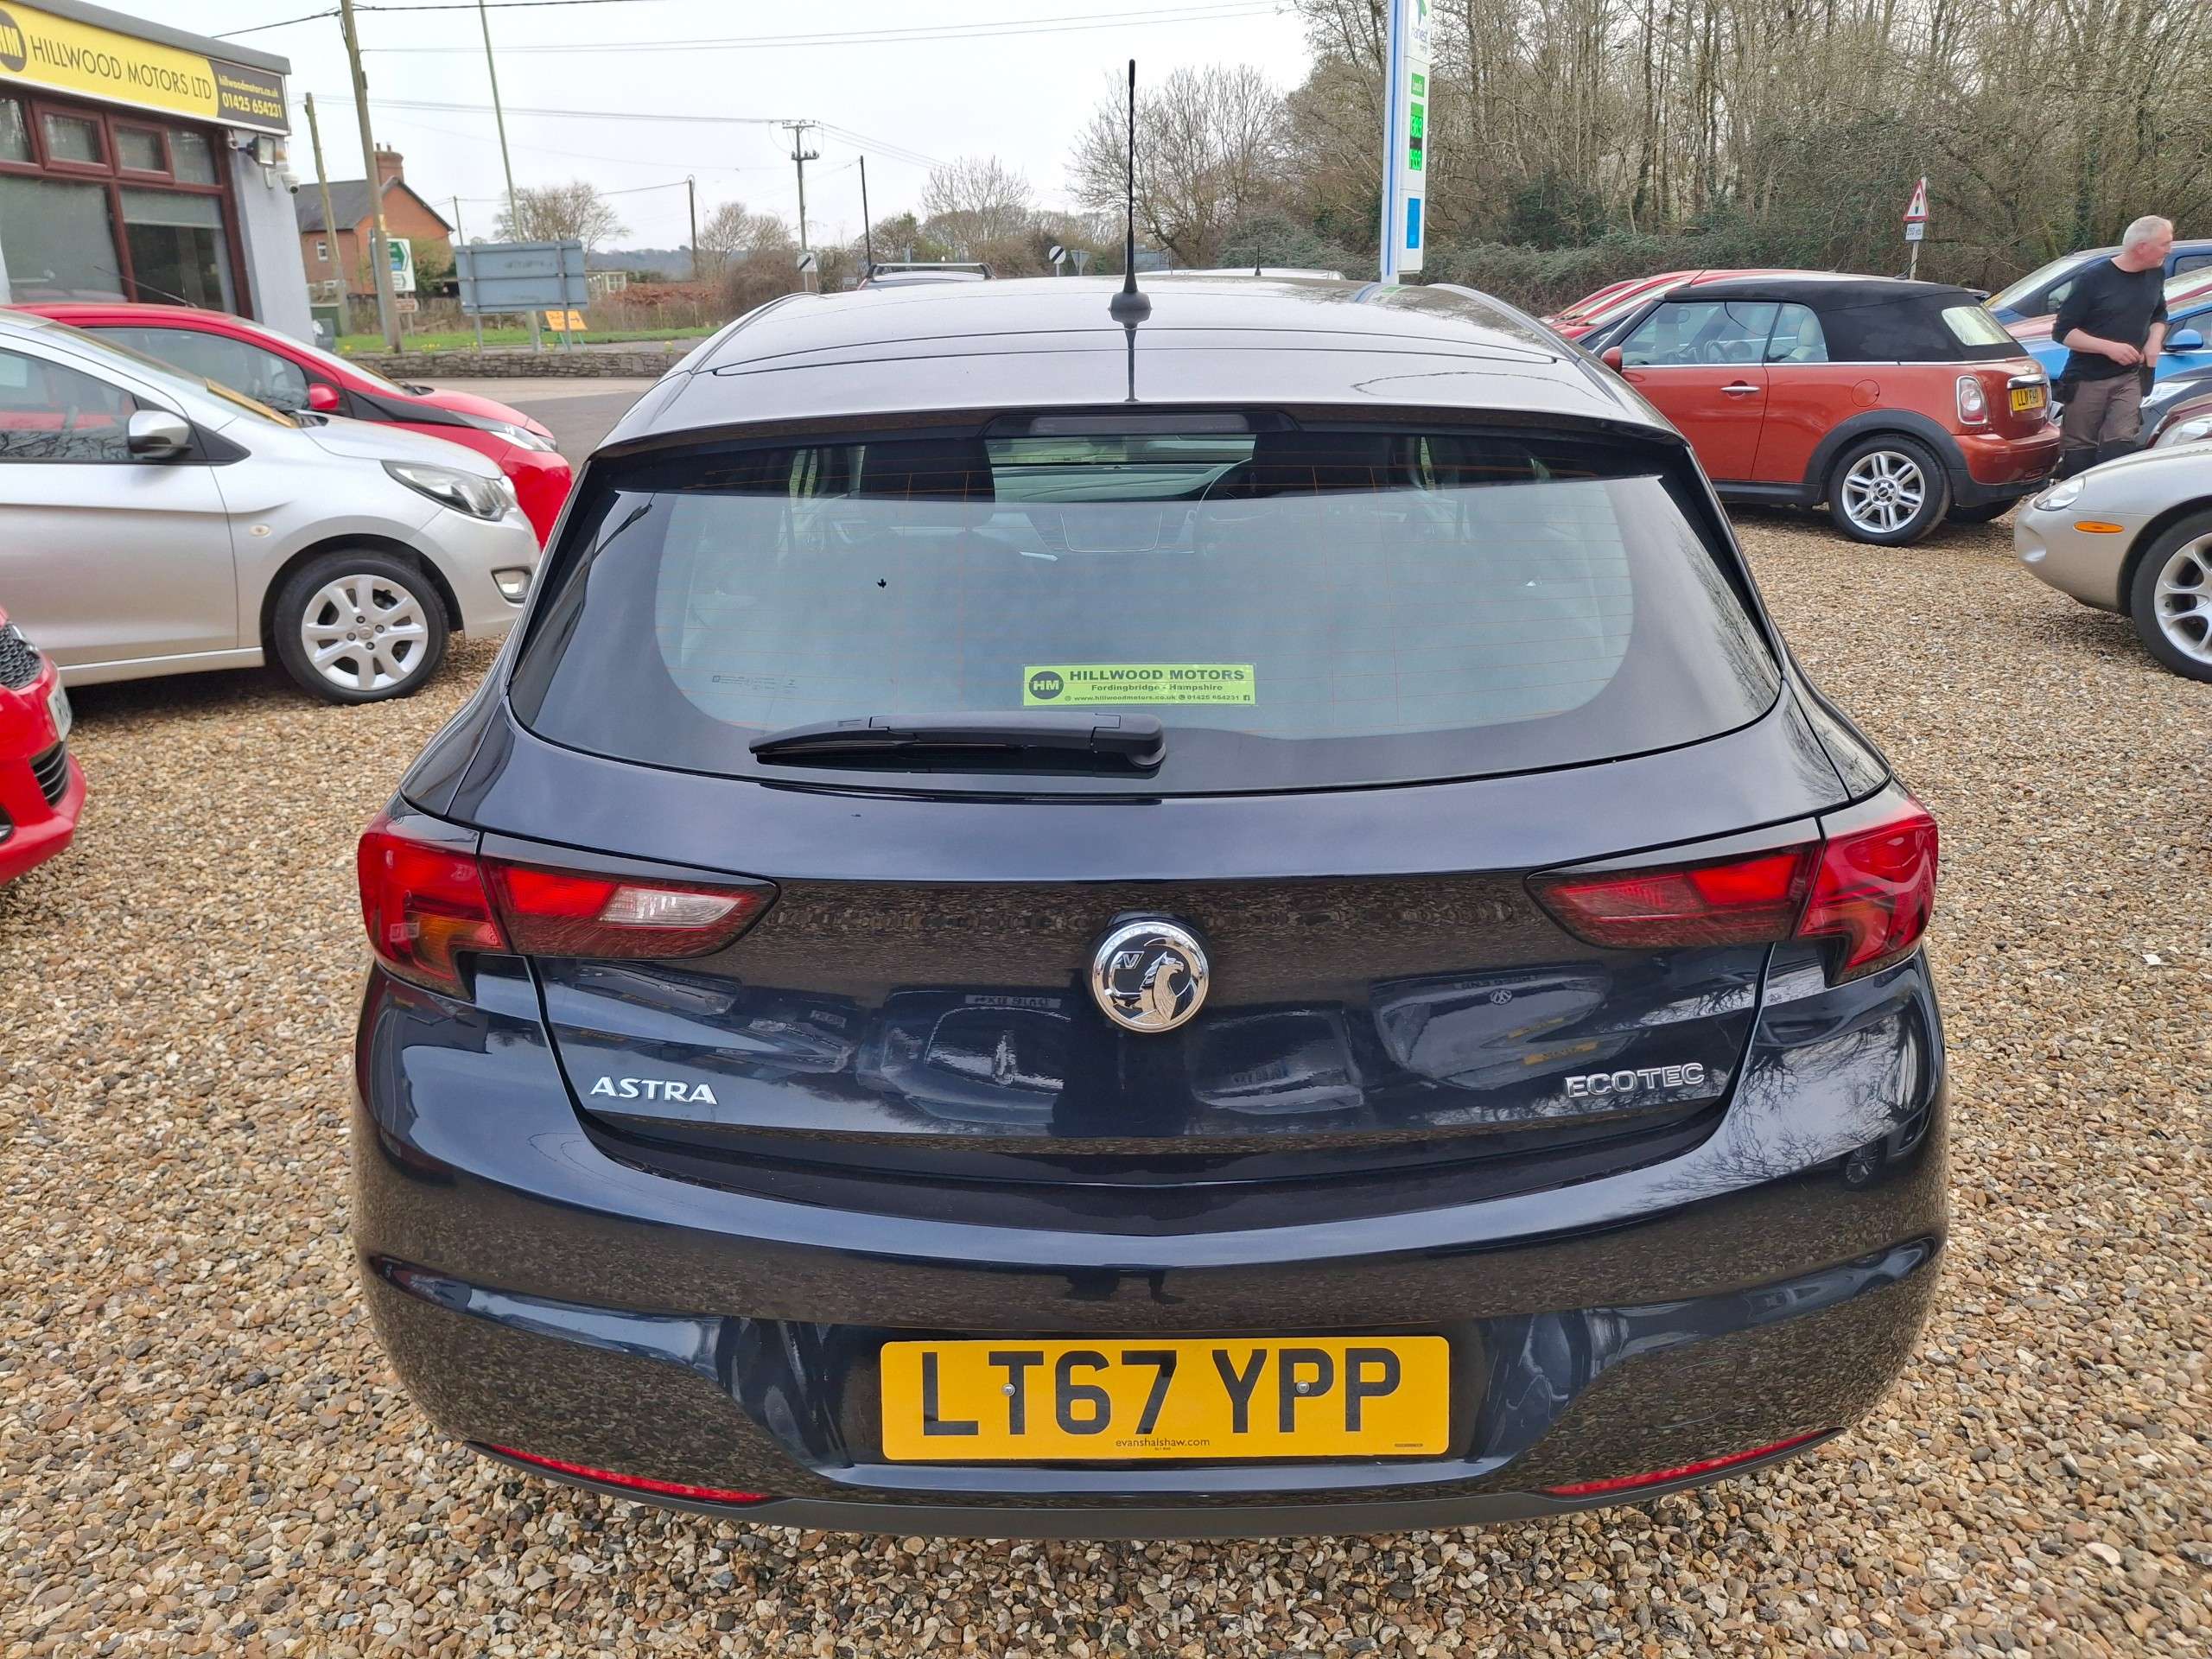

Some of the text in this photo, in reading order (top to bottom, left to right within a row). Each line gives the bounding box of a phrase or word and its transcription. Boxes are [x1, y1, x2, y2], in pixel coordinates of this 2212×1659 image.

[30, 35, 212, 99] HILLWOOD MOTORS LTD
[222, 92, 283, 118] 01425 654231
[1033, 680, 1060, 691] HM
[1070, 670, 1245, 681] HILLWOOD MOTORS
[1091, 683, 1160, 692] Fordingbridge
[1169, 683, 1224, 692] Hampshire
[589, 1076, 718, 1105] ASTRA
[1565, 1062, 1706, 1098] ECOTEC
[921, 1347, 1402, 1436] LT67 YPP
[1116, 1437, 1210, 1447] evanshalshaw.com
